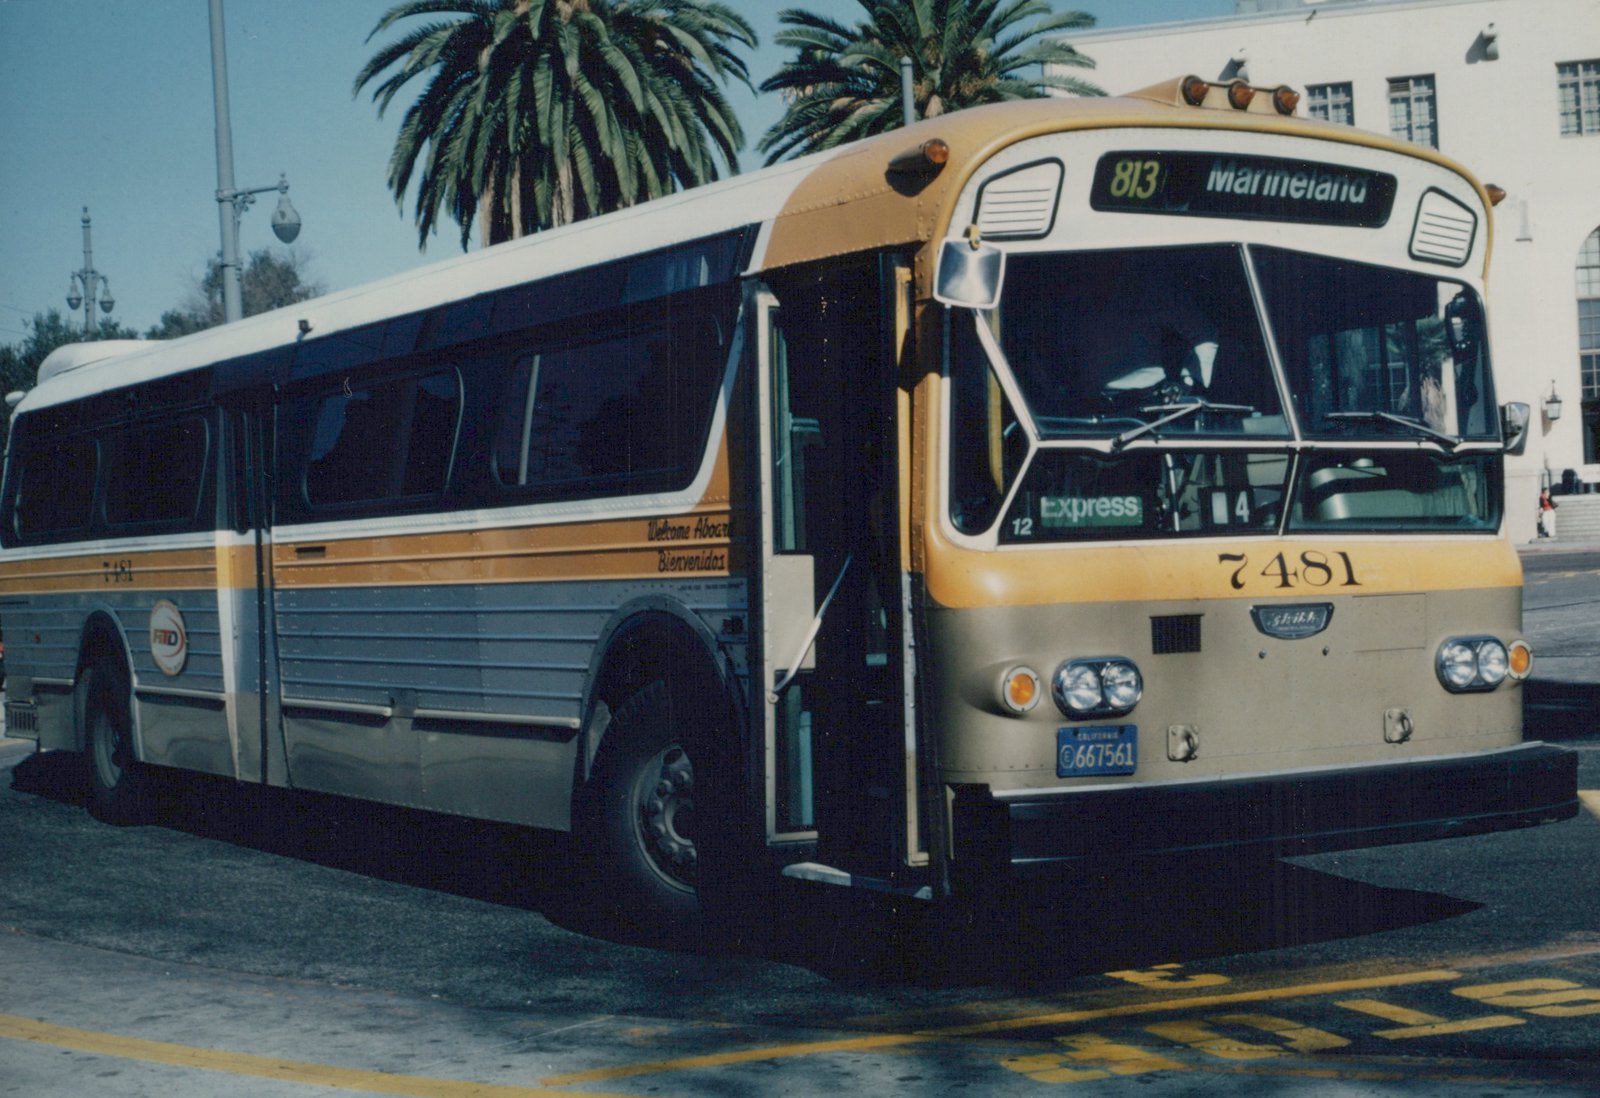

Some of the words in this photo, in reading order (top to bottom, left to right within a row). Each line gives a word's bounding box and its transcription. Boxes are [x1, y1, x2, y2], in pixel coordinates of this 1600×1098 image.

[1110, 159, 1160, 199] 813
[1206, 159, 1370, 204] Marineland
[1040, 495, 1139, 523] Express
[1235, 490, 1250, 523] 4
[648, 520, 690, 542] Welcome
[1012, 516, 1033, 536] 12
[103, 560, 134, 583] 7481
[658, 550, 726, 573] Bienvenidos
[1217, 550, 1363, 590] 7481
[153, 628, 179, 646] RTD
[1075, 742, 1135, 768] 667561
